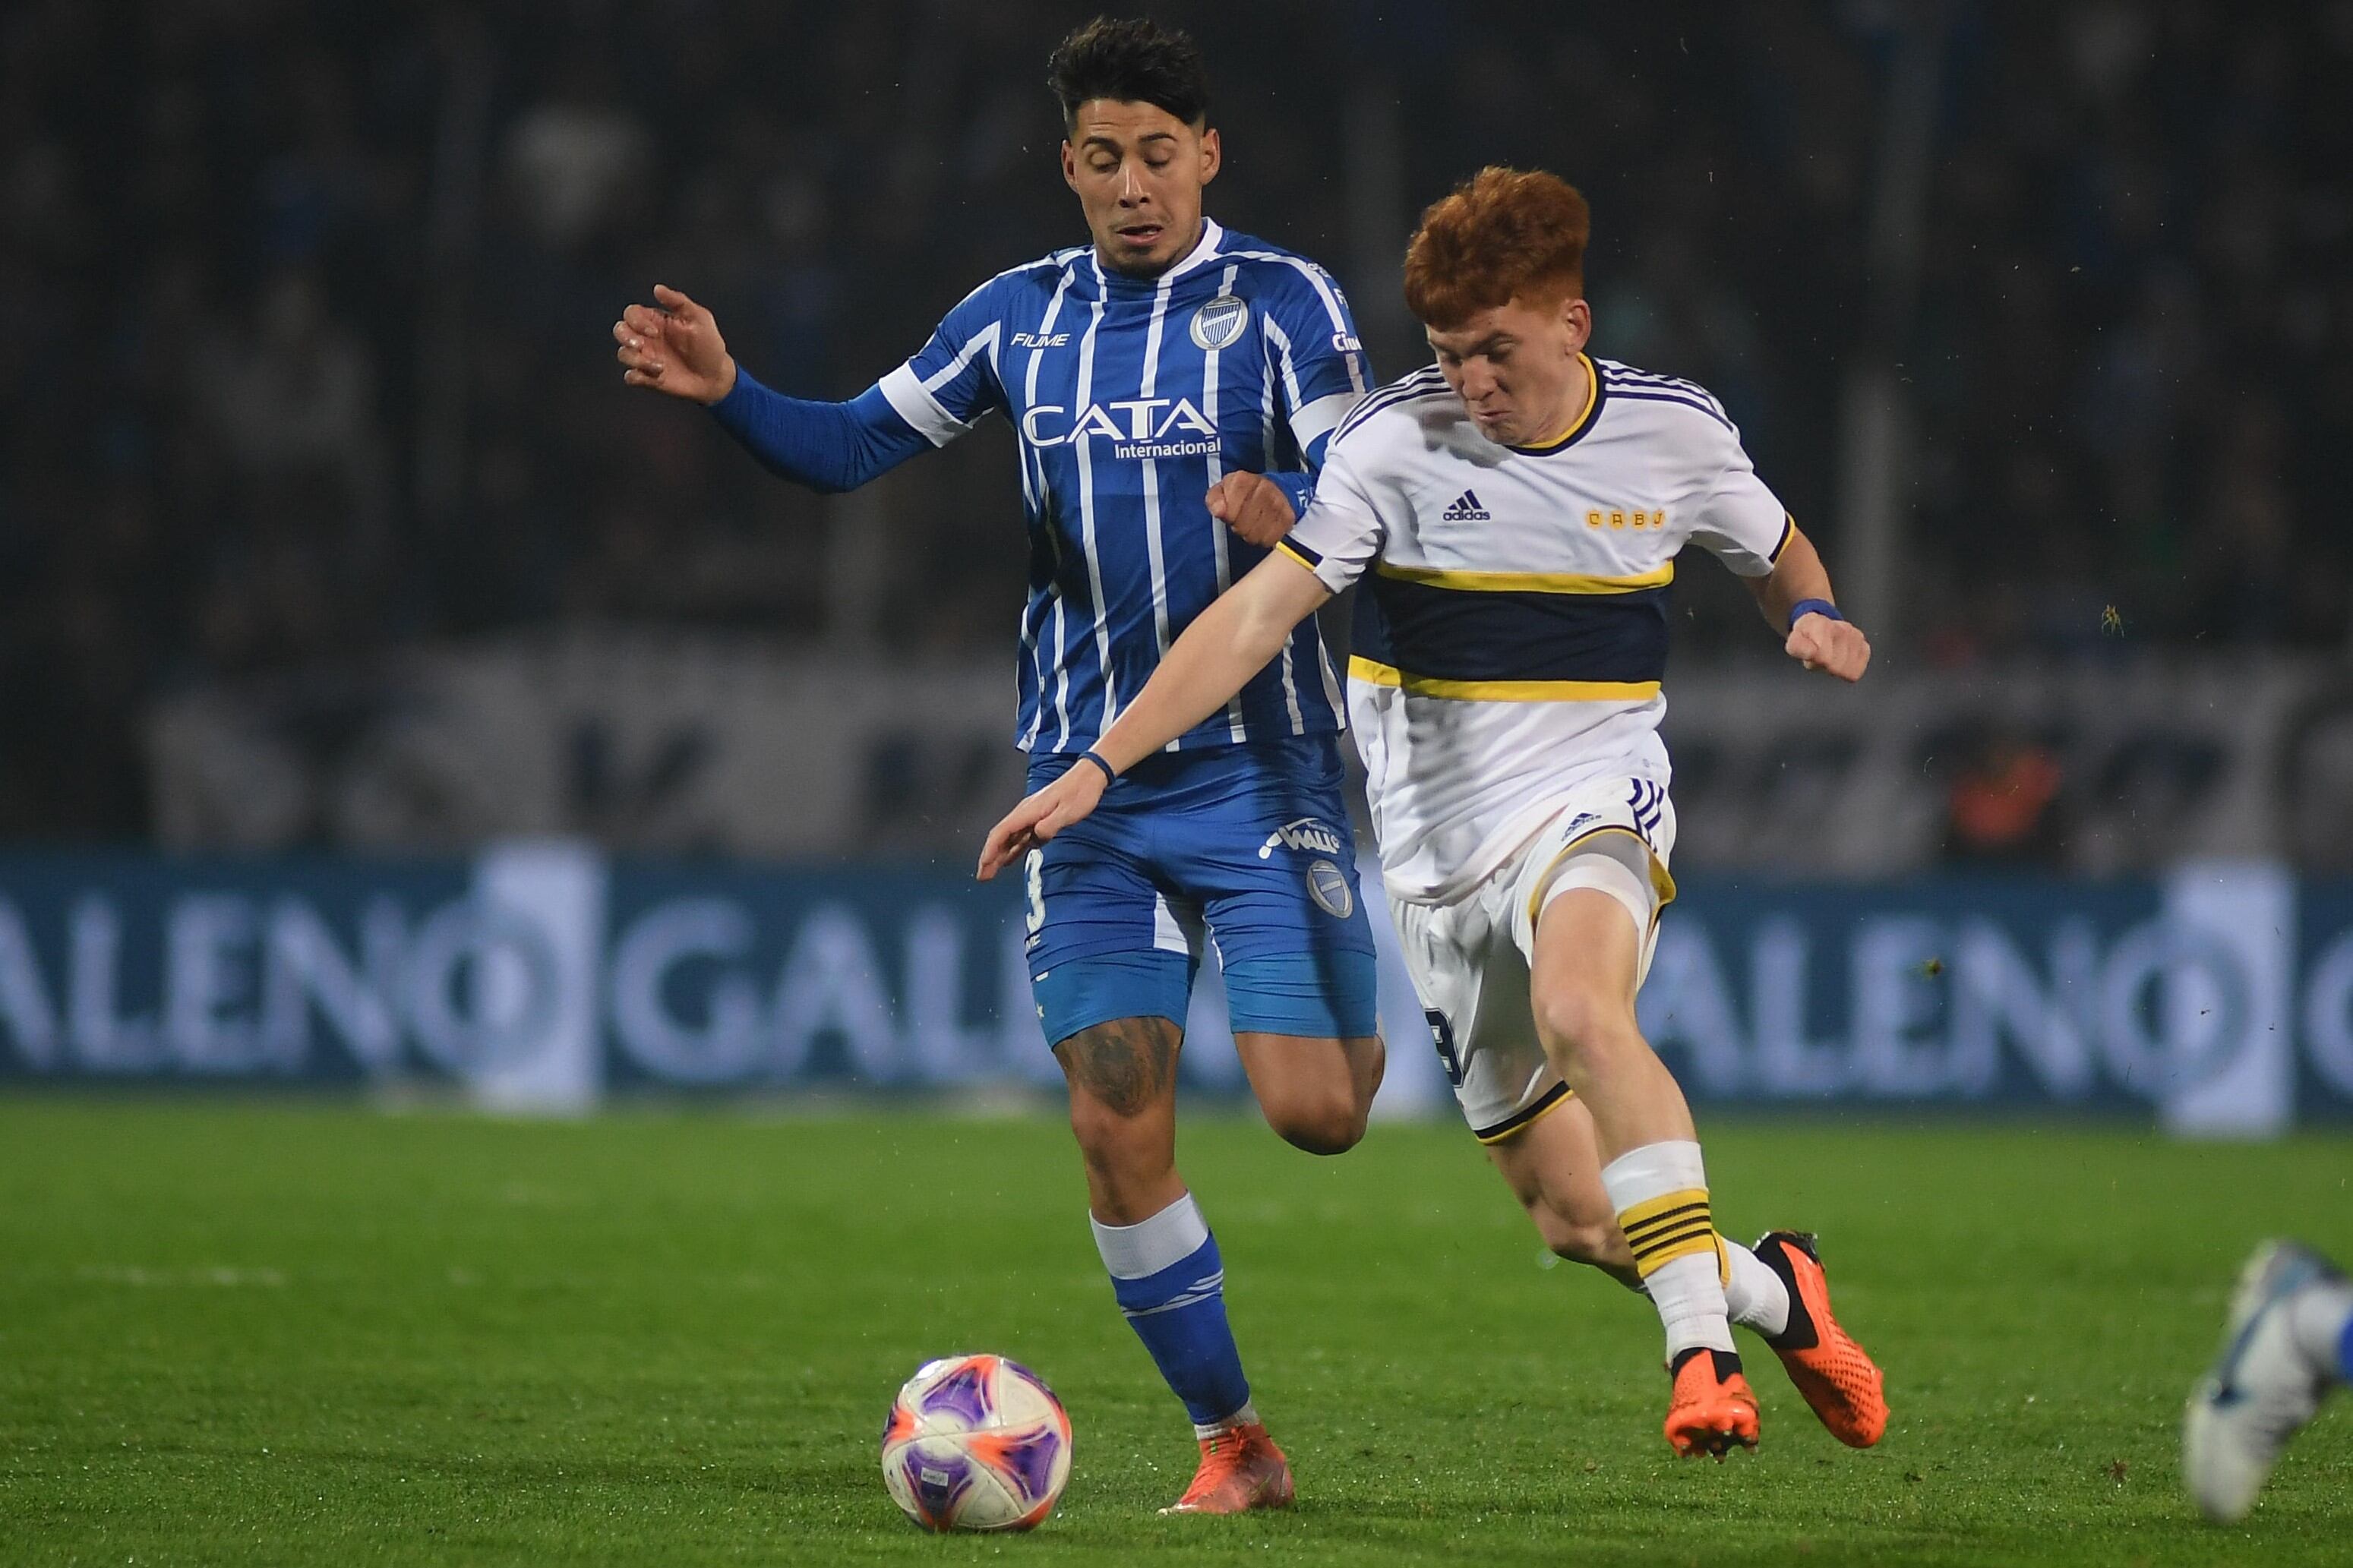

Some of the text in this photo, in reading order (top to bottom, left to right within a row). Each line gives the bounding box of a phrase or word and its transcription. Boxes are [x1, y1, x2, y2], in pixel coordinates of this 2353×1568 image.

[1010, 333, 1071, 348] FIUME
[1022, 397, 1218, 446] CATA
[1114, 437, 1221, 459] Internacional
[1442, 510, 1491, 521] adidas
[1633, 916, 2256, 1101] ALENO
